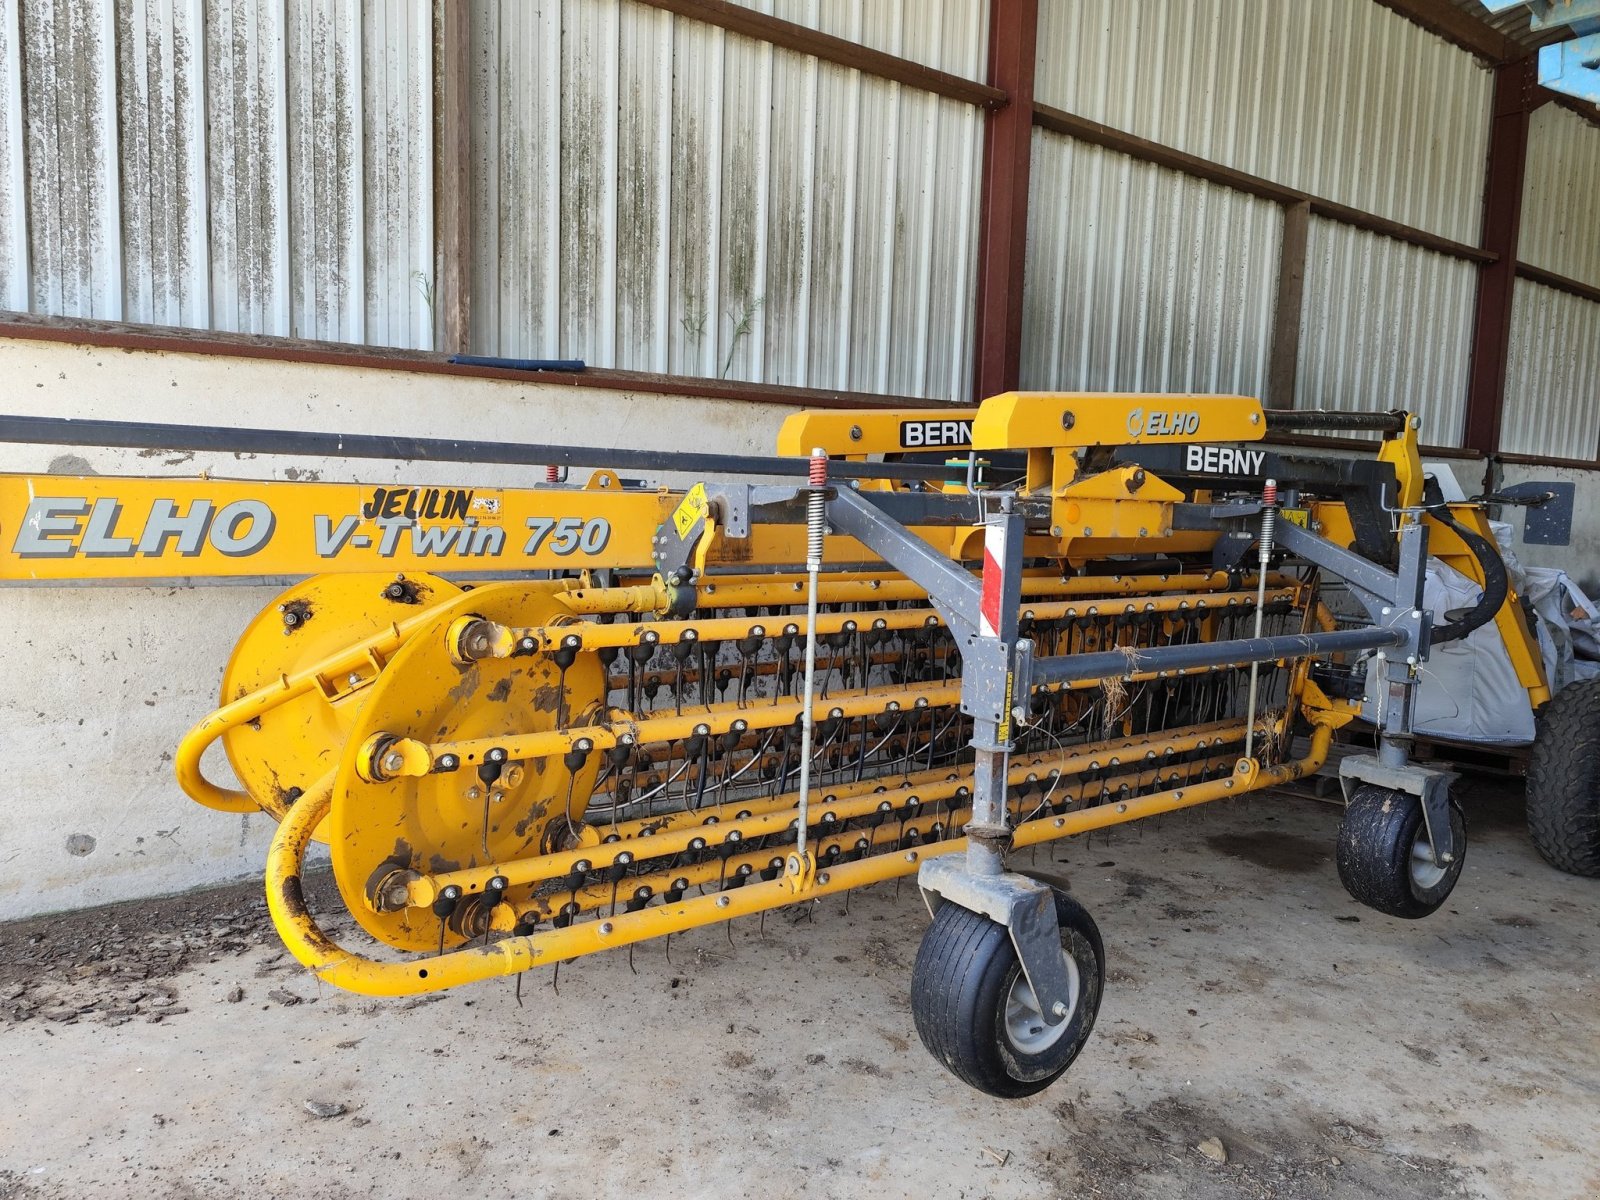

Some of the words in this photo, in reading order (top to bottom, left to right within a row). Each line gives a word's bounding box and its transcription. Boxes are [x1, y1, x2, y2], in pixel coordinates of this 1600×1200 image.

[1146, 411, 1200, 436] ELHO
[1186, 445, 1265, 476] BERNY
[363, 487, 474, 520] JEULIN
[11, 496, 276, 558] ELHO
[314, 514, 507, 558] V-Twin
[522, 517, 611, 556] 750
